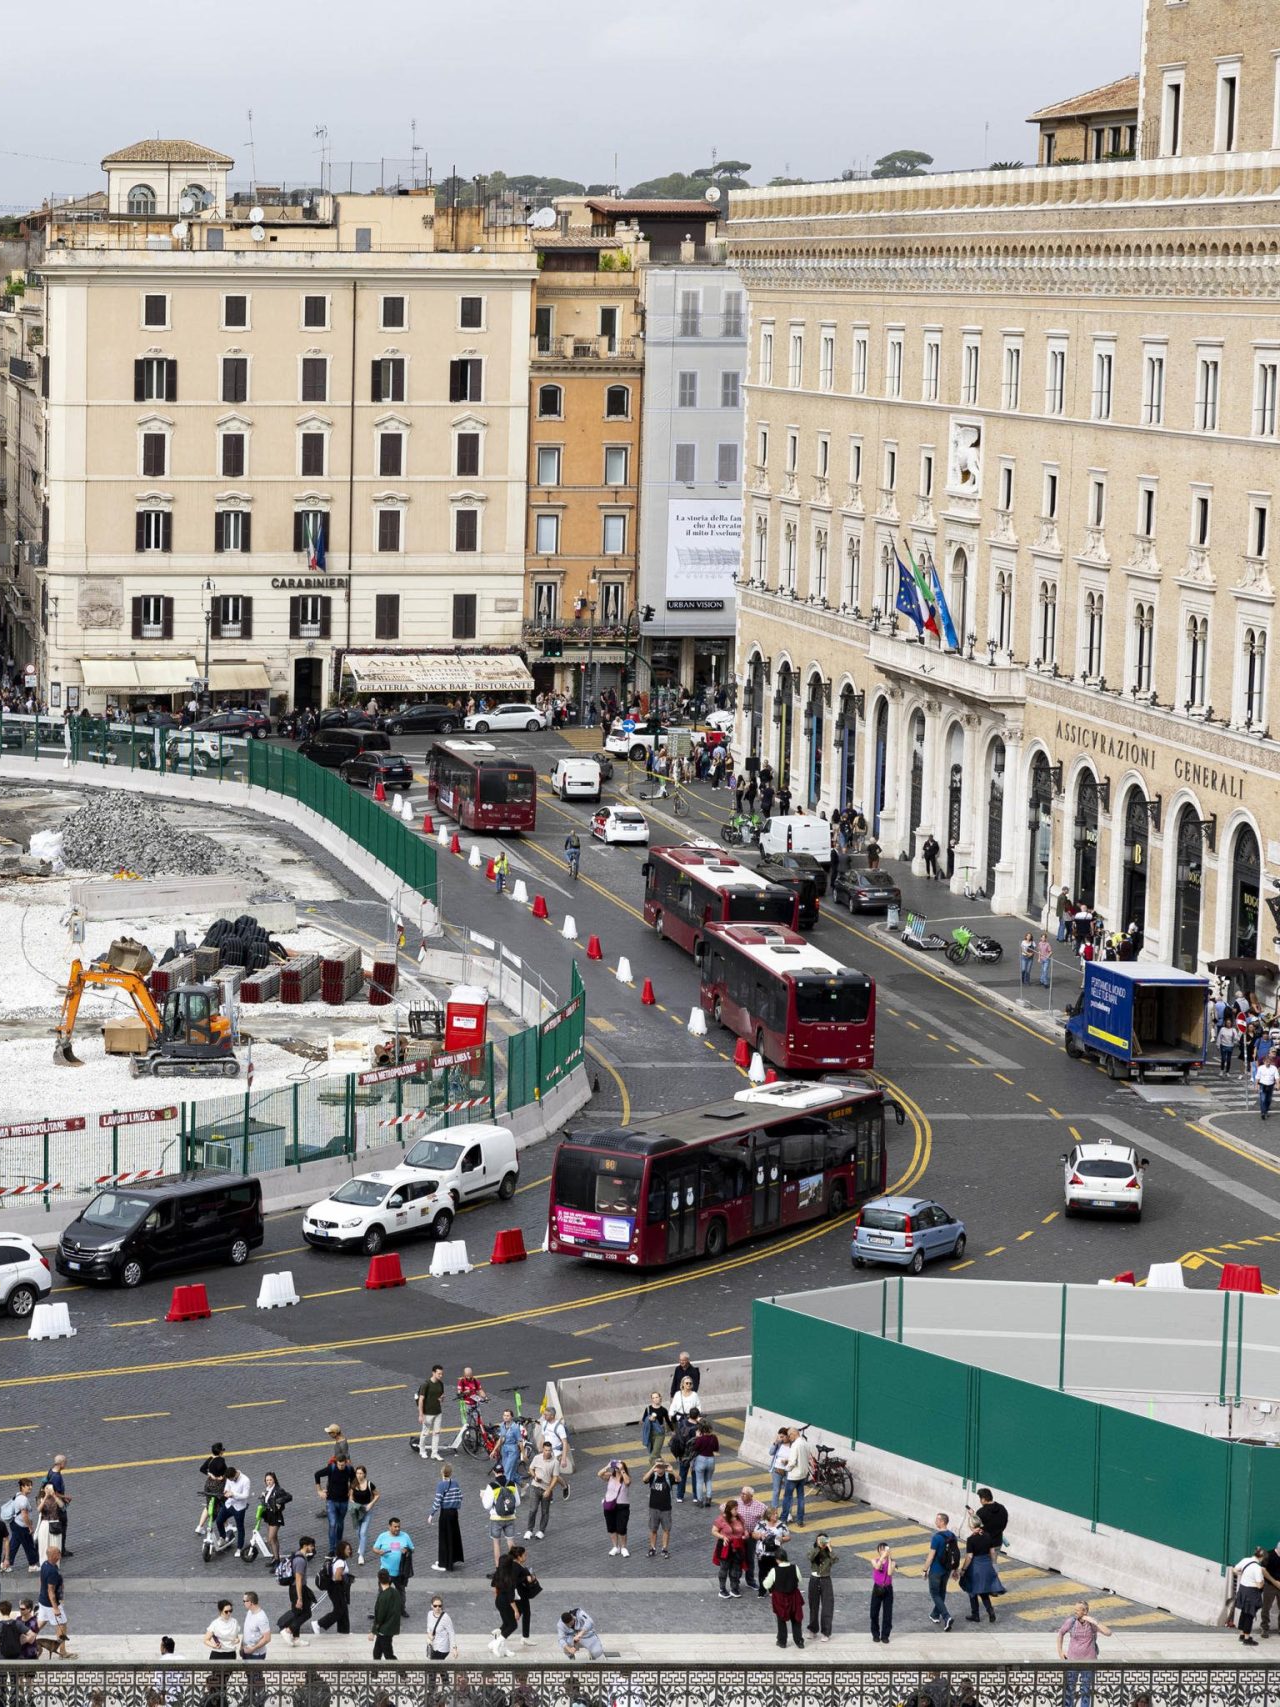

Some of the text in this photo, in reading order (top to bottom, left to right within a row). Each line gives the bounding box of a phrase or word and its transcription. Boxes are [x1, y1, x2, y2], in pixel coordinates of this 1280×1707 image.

[271, 578, 348, 588] CARABINIERI
[474, 682, 532, 690] RISTORANTE
[1056, 720, 1244, 800] ASSICVRAZIONI GENERALI
[1134, 844, 1142, 864] B
[103, 1114, 128, 1126] LAVORI
[129, 1112, 149, 1123] LINEA
[10, 1120, 67, 1137] METROPOLITANE
